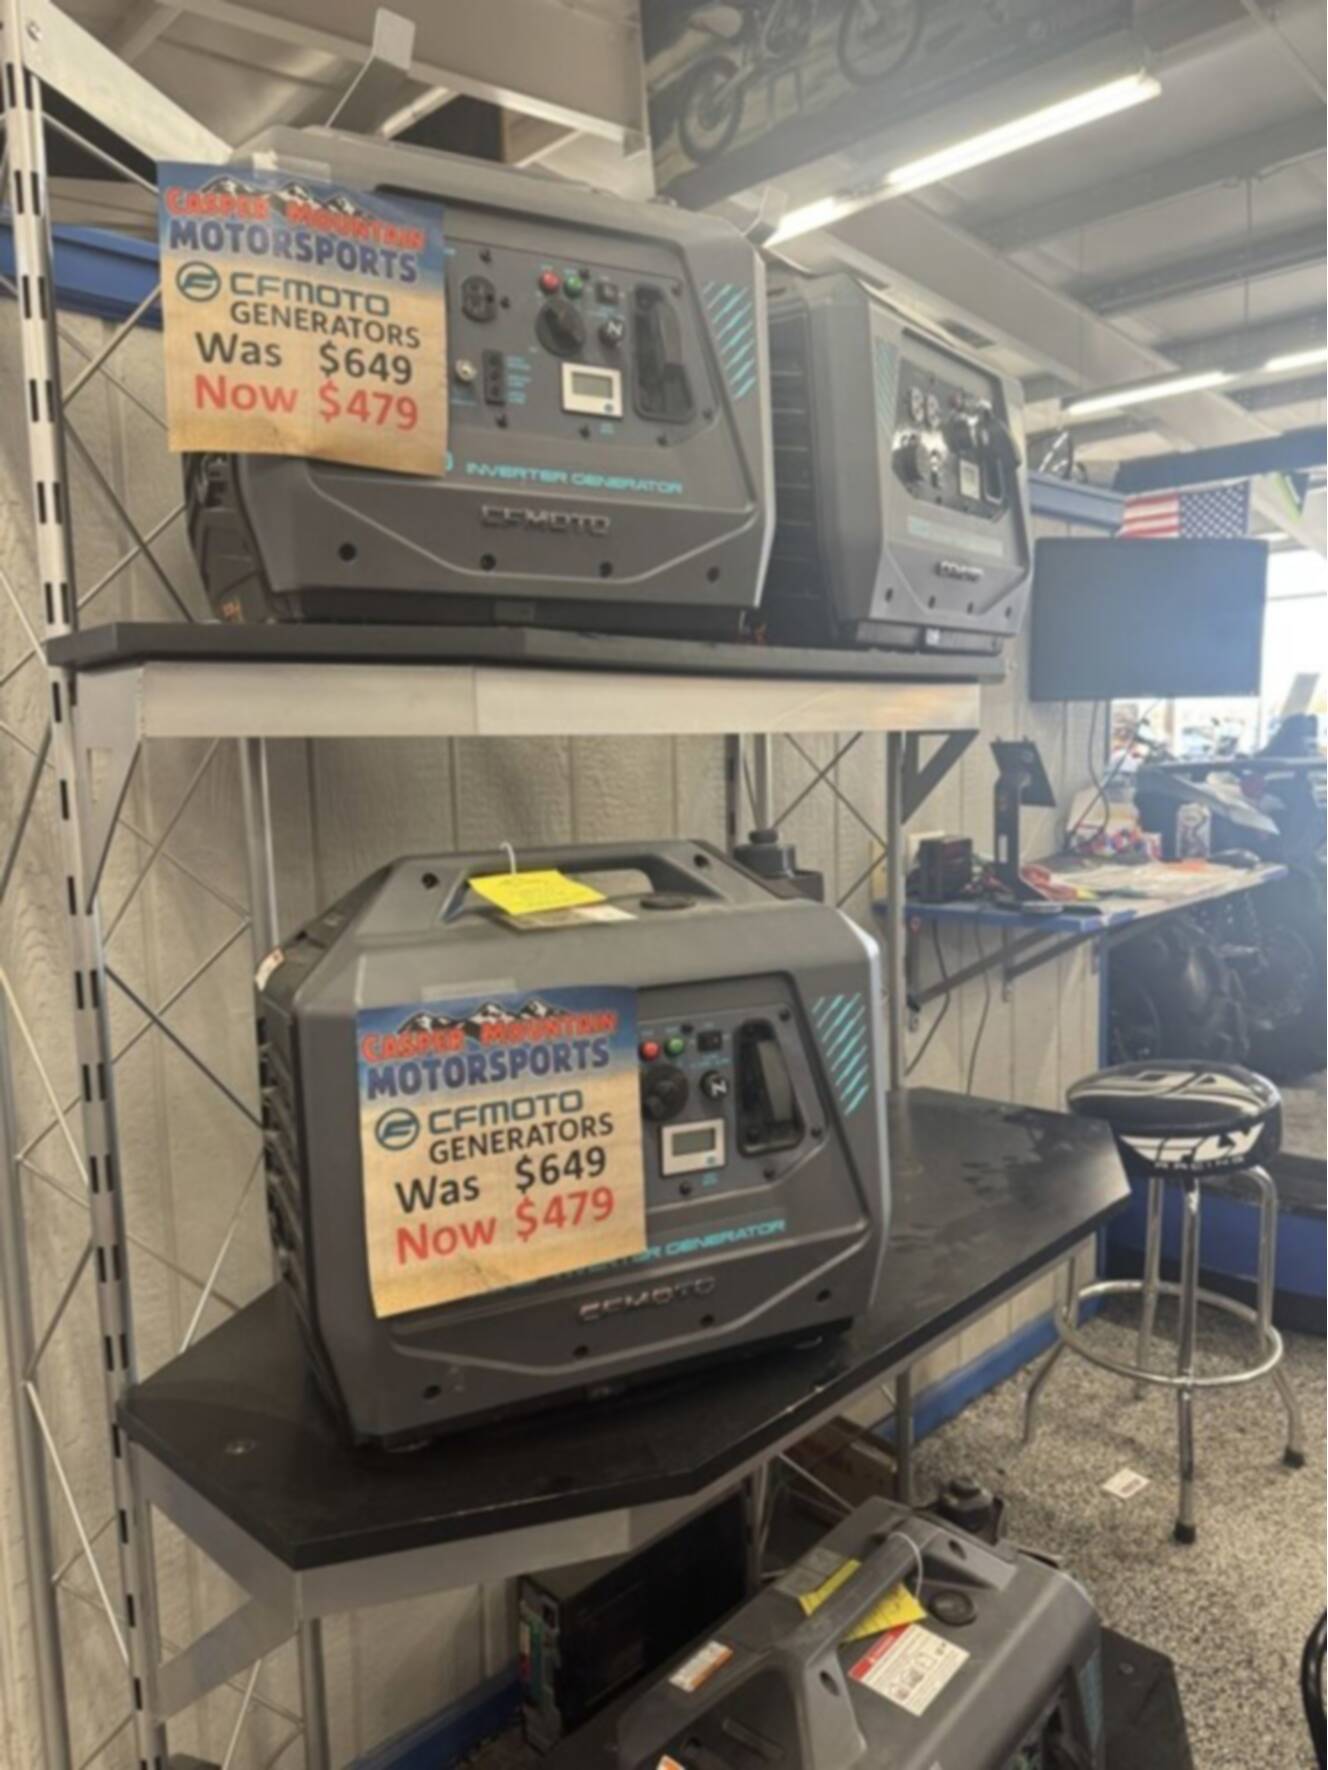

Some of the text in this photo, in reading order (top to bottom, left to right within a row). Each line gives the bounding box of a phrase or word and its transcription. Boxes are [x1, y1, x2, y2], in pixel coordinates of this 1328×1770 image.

[169, 219, 418, 284] MOTORSPORTS
[229, 271, 391, 318] CFMOTO
[230, 301, 421, 350] GENERATORS
[195, 331, 413, 386] Was $649
[194, 373, 299, 414] Now
[318, 379, 419, 431] $479
[466, 461, 569, 484] INVERTER
[570, 472, 684, 495] GENERATOR
[367, 1037, 610, 1101] MOTORSPORTS
[428, 1088, 583, 1135] CFMOTO
[429, 1113, 614, 1165] GENERATORS
[395, 1145, 607, 1214] Was $649
[395, 1215, 497, 1266] Now
[515, 1185, 616, 1244] $479
[665, 1218, 786, 1257] GENERATOR
